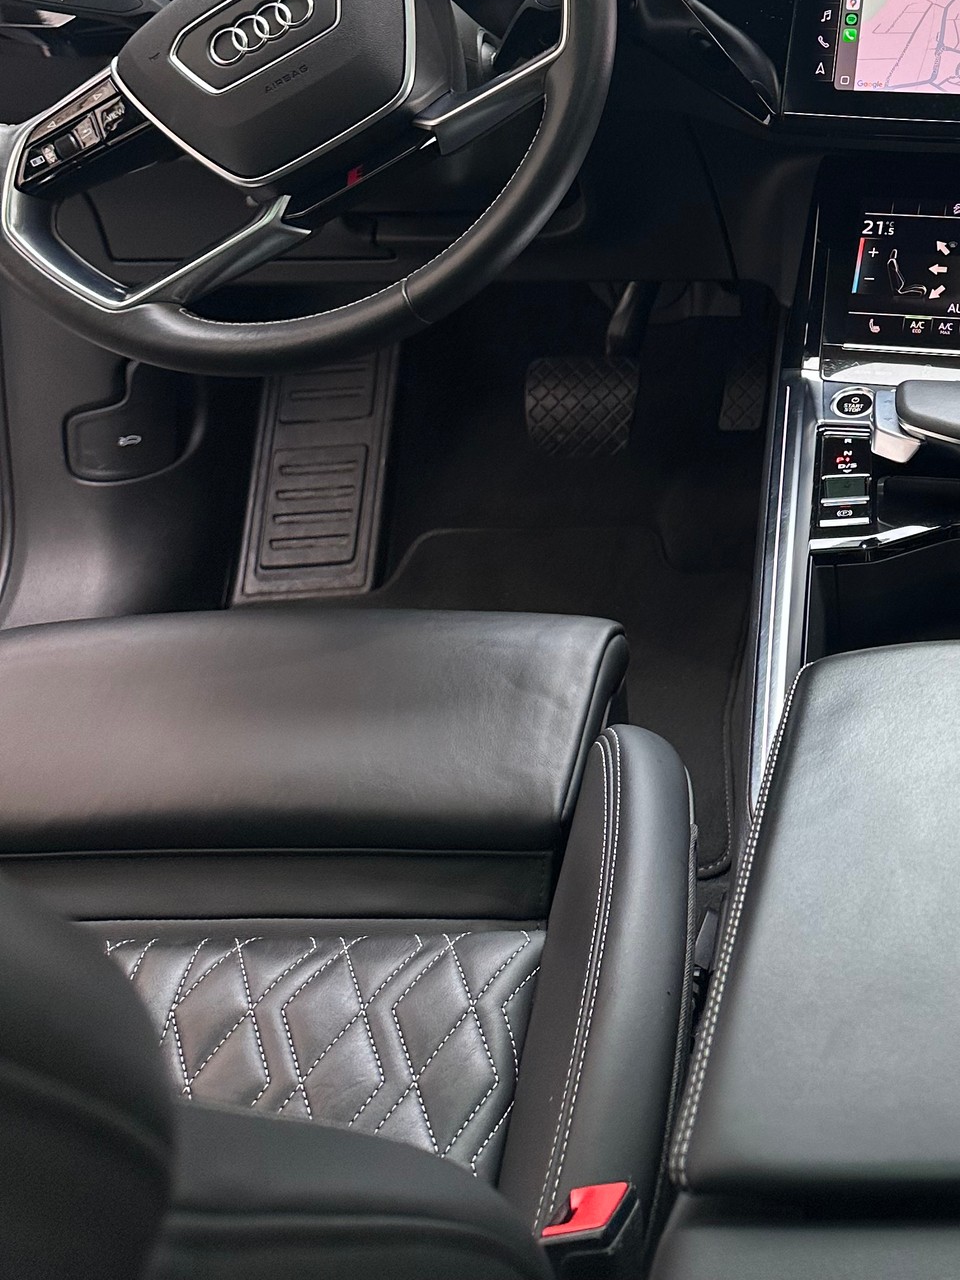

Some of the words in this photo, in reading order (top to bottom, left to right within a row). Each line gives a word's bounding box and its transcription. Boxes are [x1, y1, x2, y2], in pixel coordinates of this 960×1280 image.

[265, 64, 309, 94] AIRBAG
[856, 80, 883, 89] Google
[106, 108, 125, 122] VIEW
[910, 321, 925, 329] A/C
[938, 322, 954, 331] A/C
